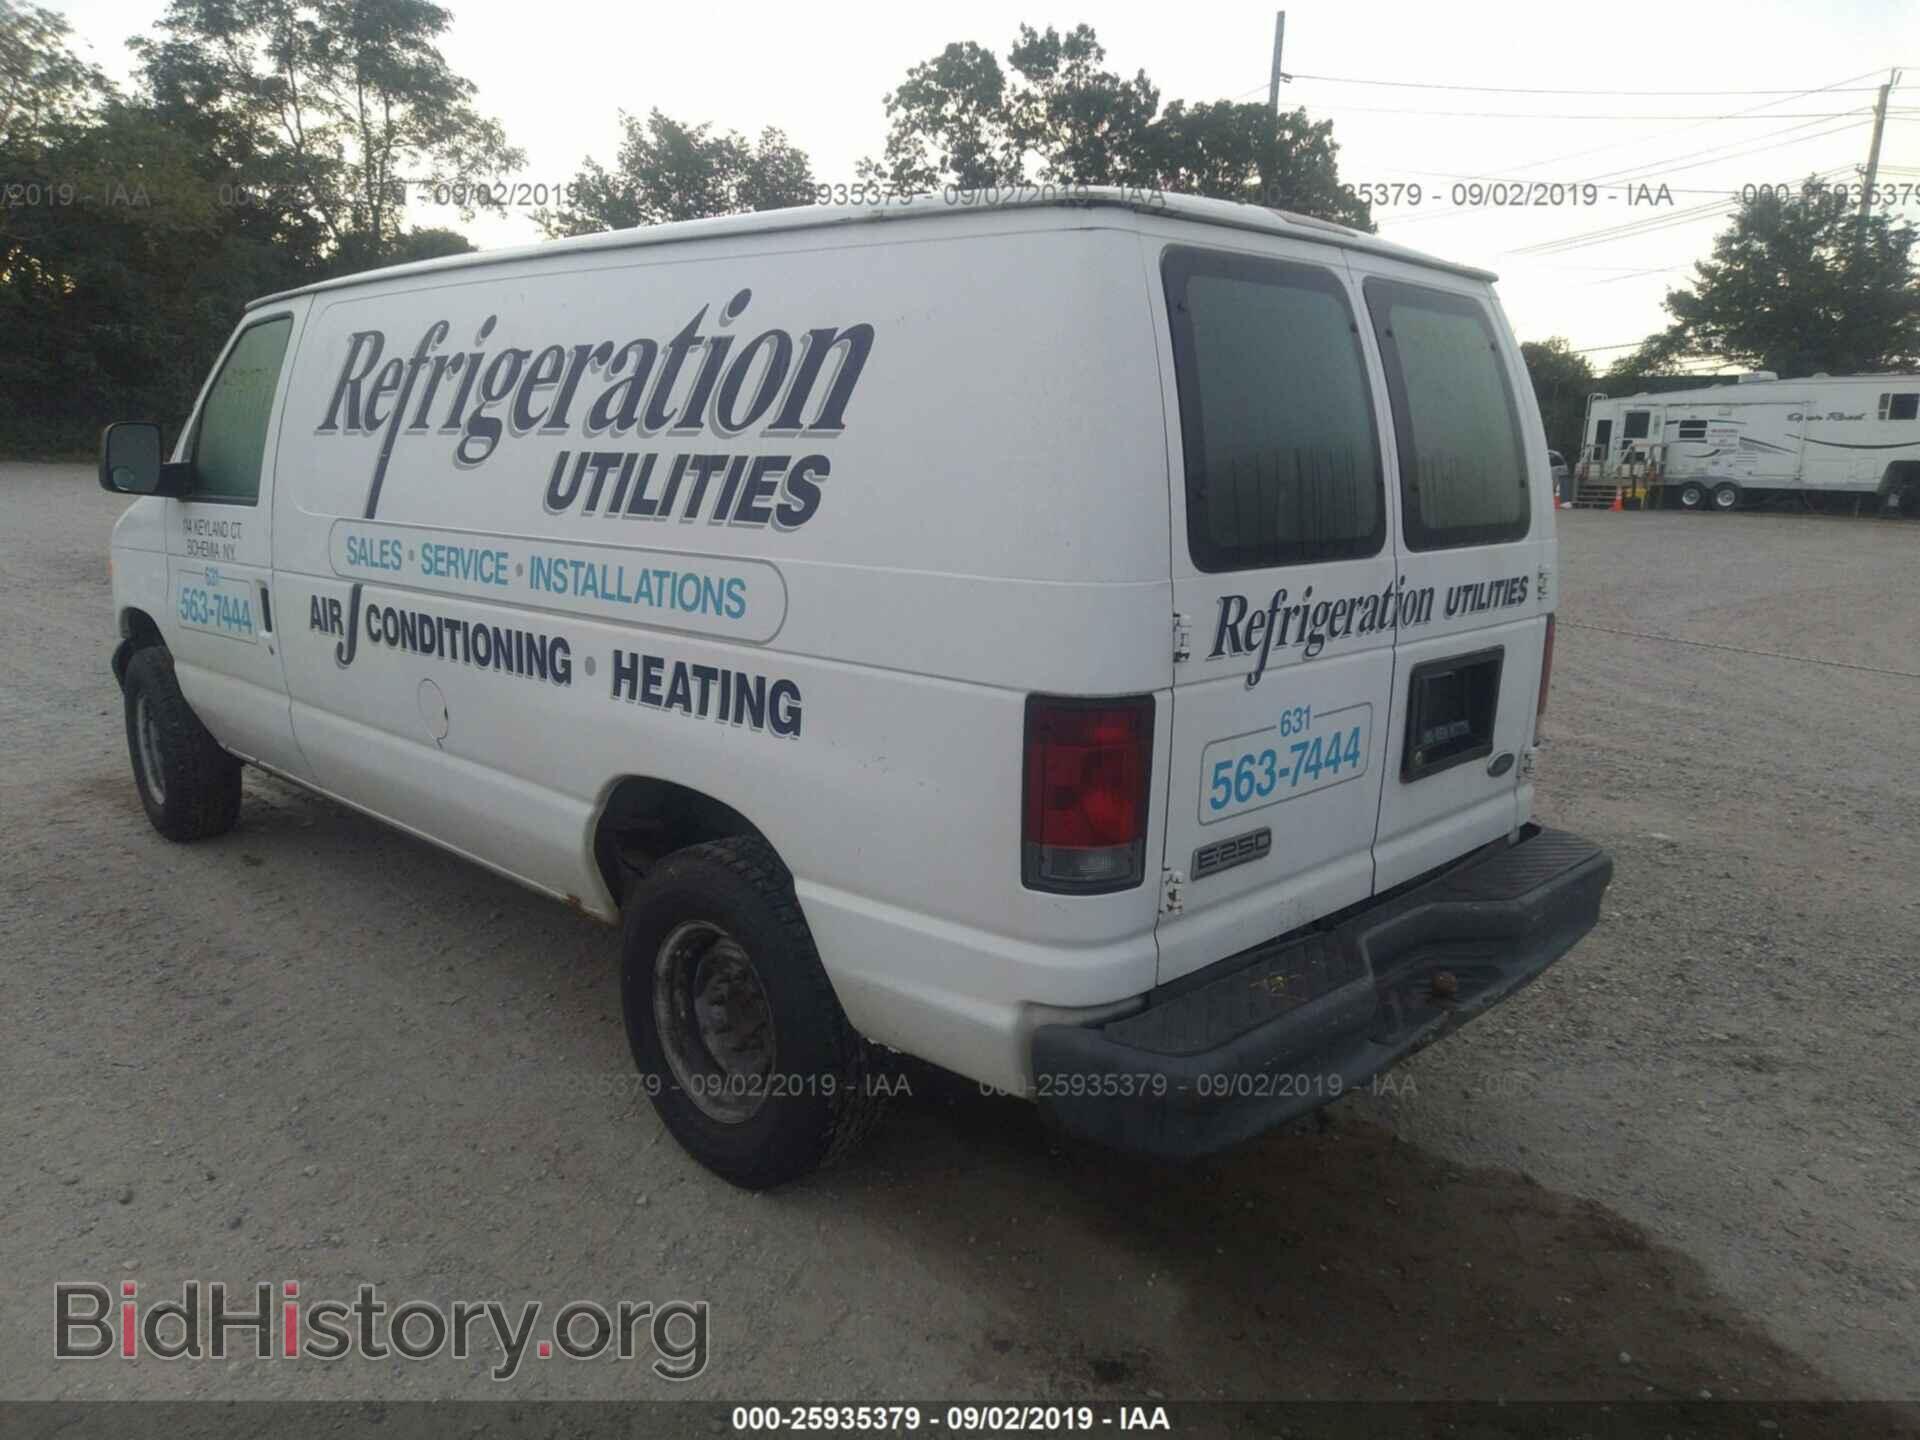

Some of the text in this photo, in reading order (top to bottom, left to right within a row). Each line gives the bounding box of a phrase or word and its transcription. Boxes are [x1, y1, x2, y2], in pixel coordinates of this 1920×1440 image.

[316, 288, 876, 520] Refrigeration
[543, 450, 832, 530] UTILITIES
[180, 587, 252, 634] 563-7444
[346, 535, 747, 620] SALES SERVICE INSTALLATIONS
[310, 594, 803, 739] AIR CONDITIONING HEATING
[1206, 576, 1529, 690] Refrigeration UTILITIES
[1280, 704, 1312, 737] 631
[1210, 726, 1361, 810] 563-7444
